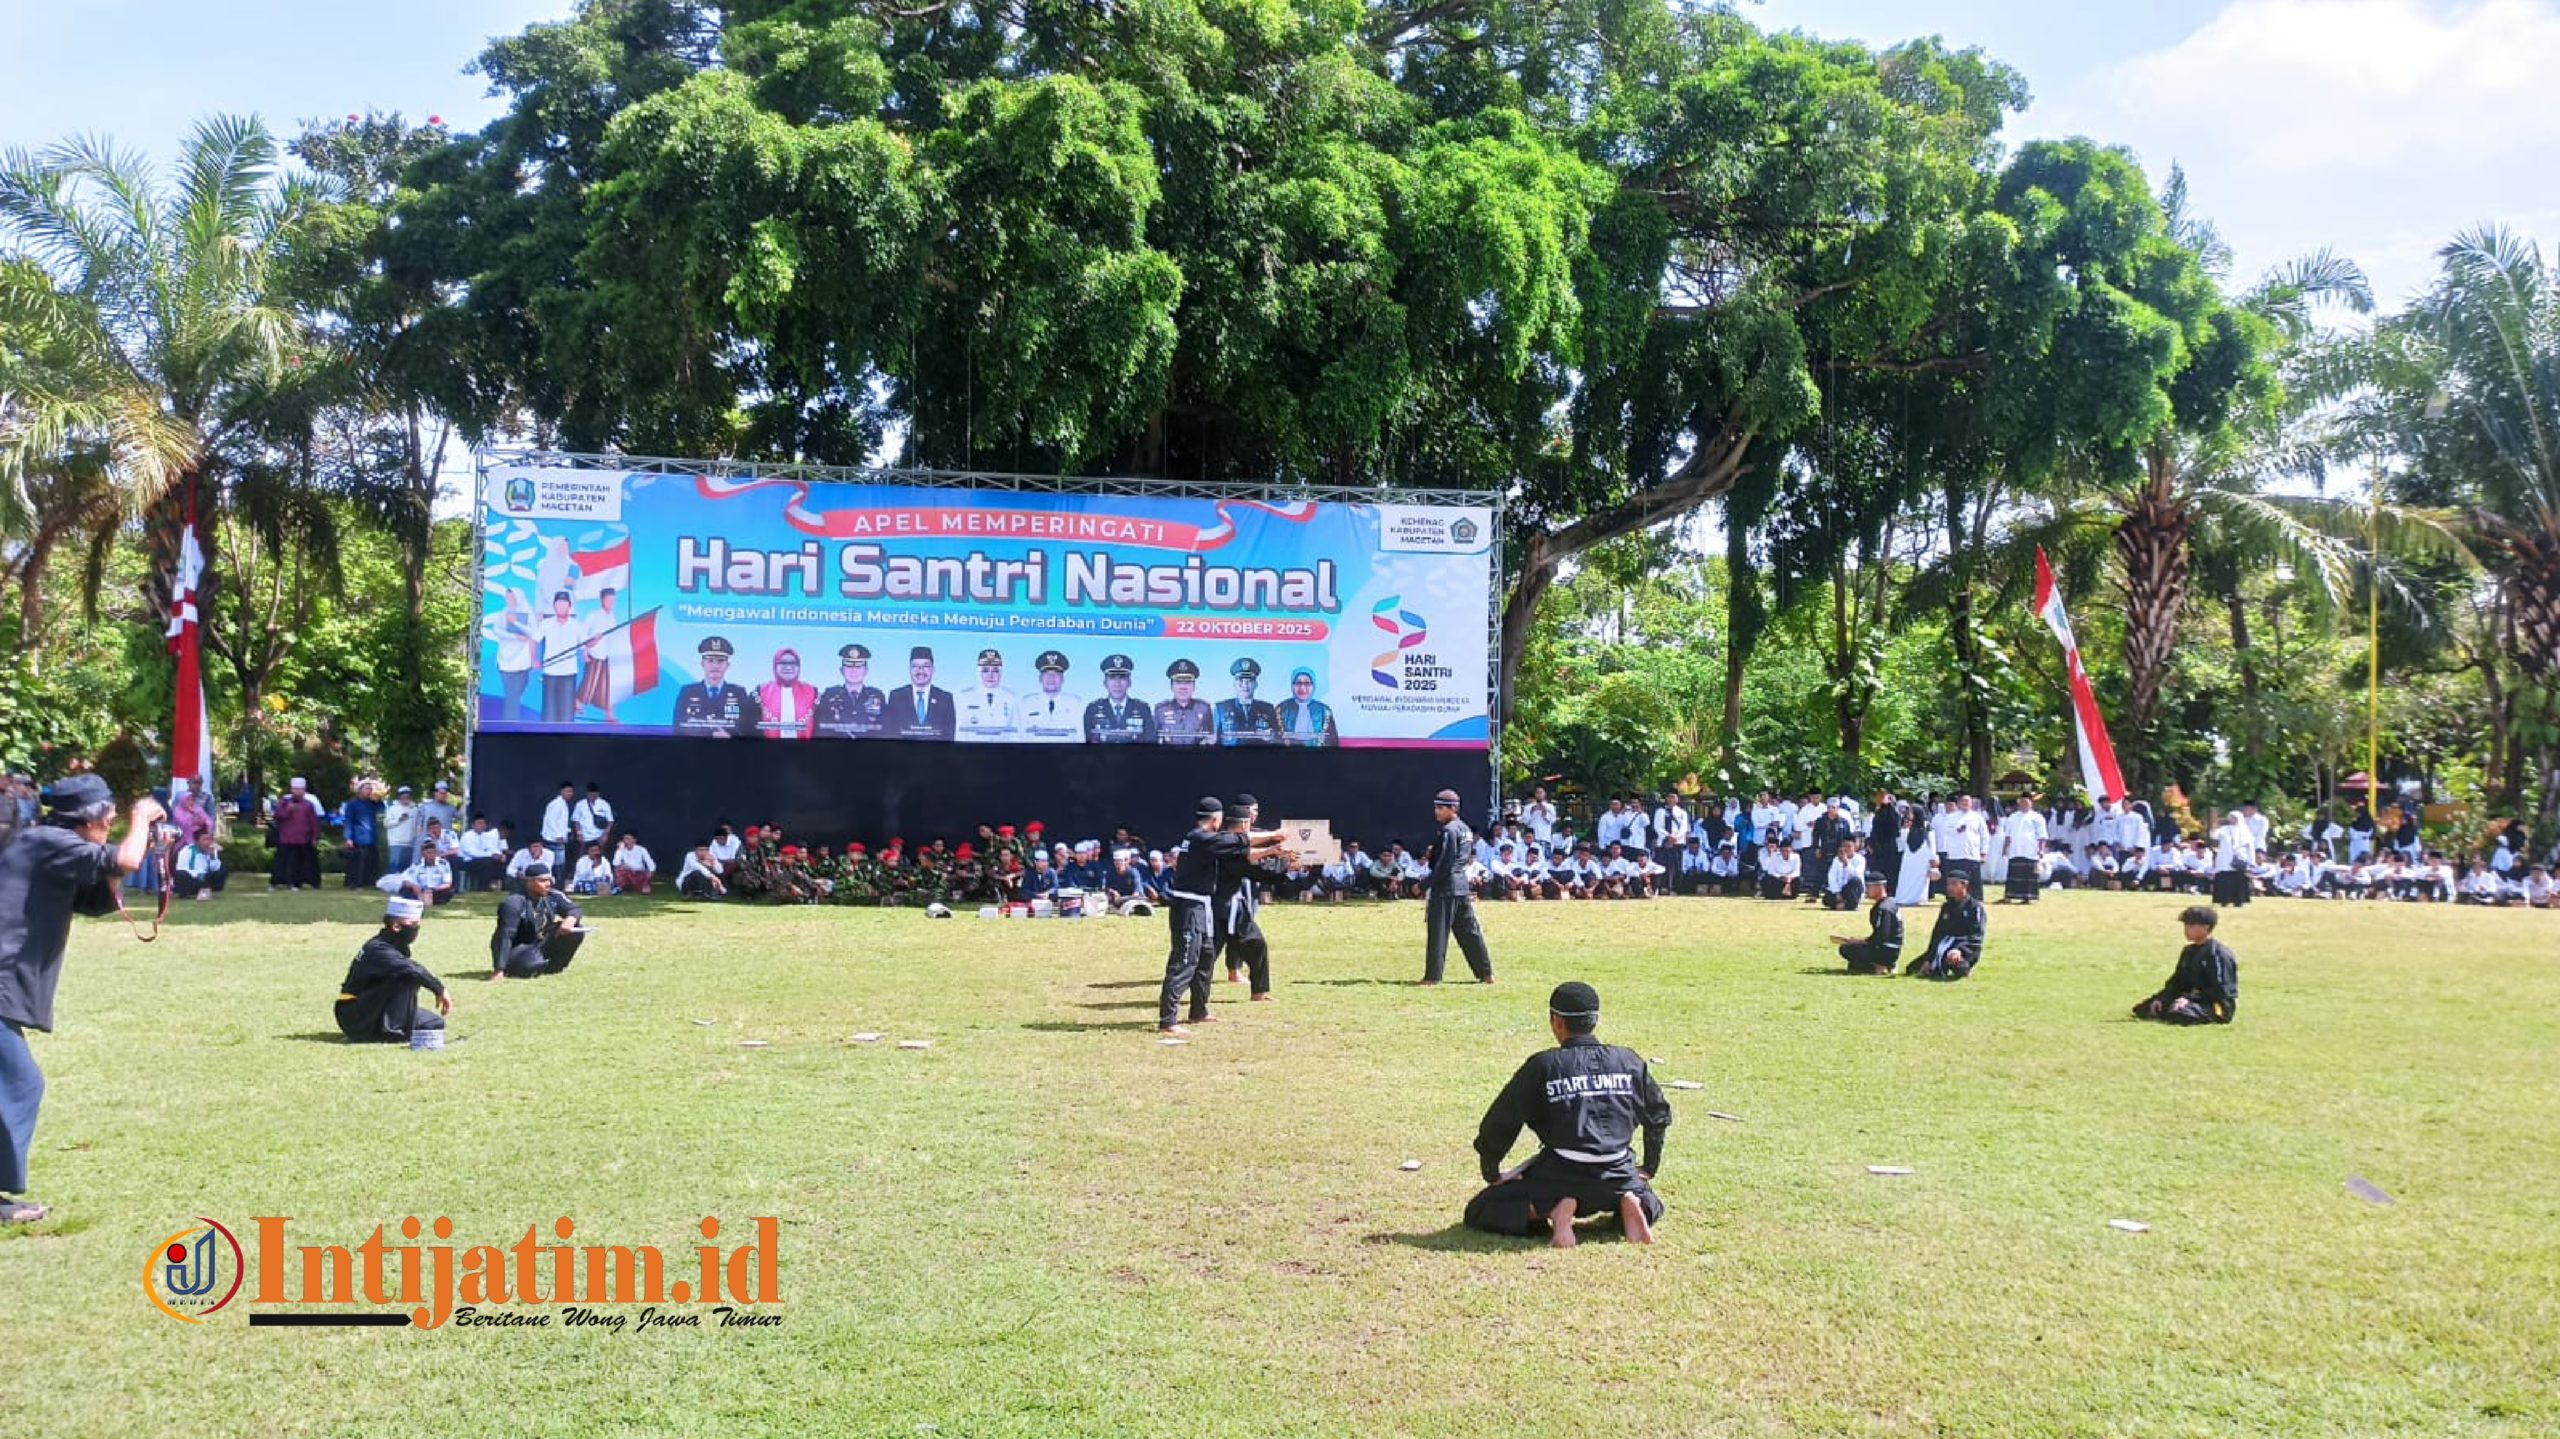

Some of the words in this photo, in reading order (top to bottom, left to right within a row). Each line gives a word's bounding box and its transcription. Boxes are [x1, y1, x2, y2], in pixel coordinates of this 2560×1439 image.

[853, 513, 929, 533] APEL
[942, 514, 1165, 541] MEMPERINGATI
[677, 536, 823, 597] Hari
[840, 543, 1046, 602] Santri
[1064, 551, 1340, 612] Nasional
[781, 607, 862, 623] Indonesia
[867, 610, 939, 625] Merdeka
[944, 612, 1005, 629] Menuju
[1009, 615, 1096, 630] Peradaban
[1176, 621, 1196, 633] 22
[1200, 622, 1273, 635] OKTOBER
[1277, 624, 1312, 636] 2025
[1404, 654, 1436, 665] HARI
[1404, 666, 1452, 678] SANTRI
[1404, 680, 1437, 691] 2025
[1546, 1076, 1588, 1096] START
[1594, 1073, 1632, 1090] UNITY
